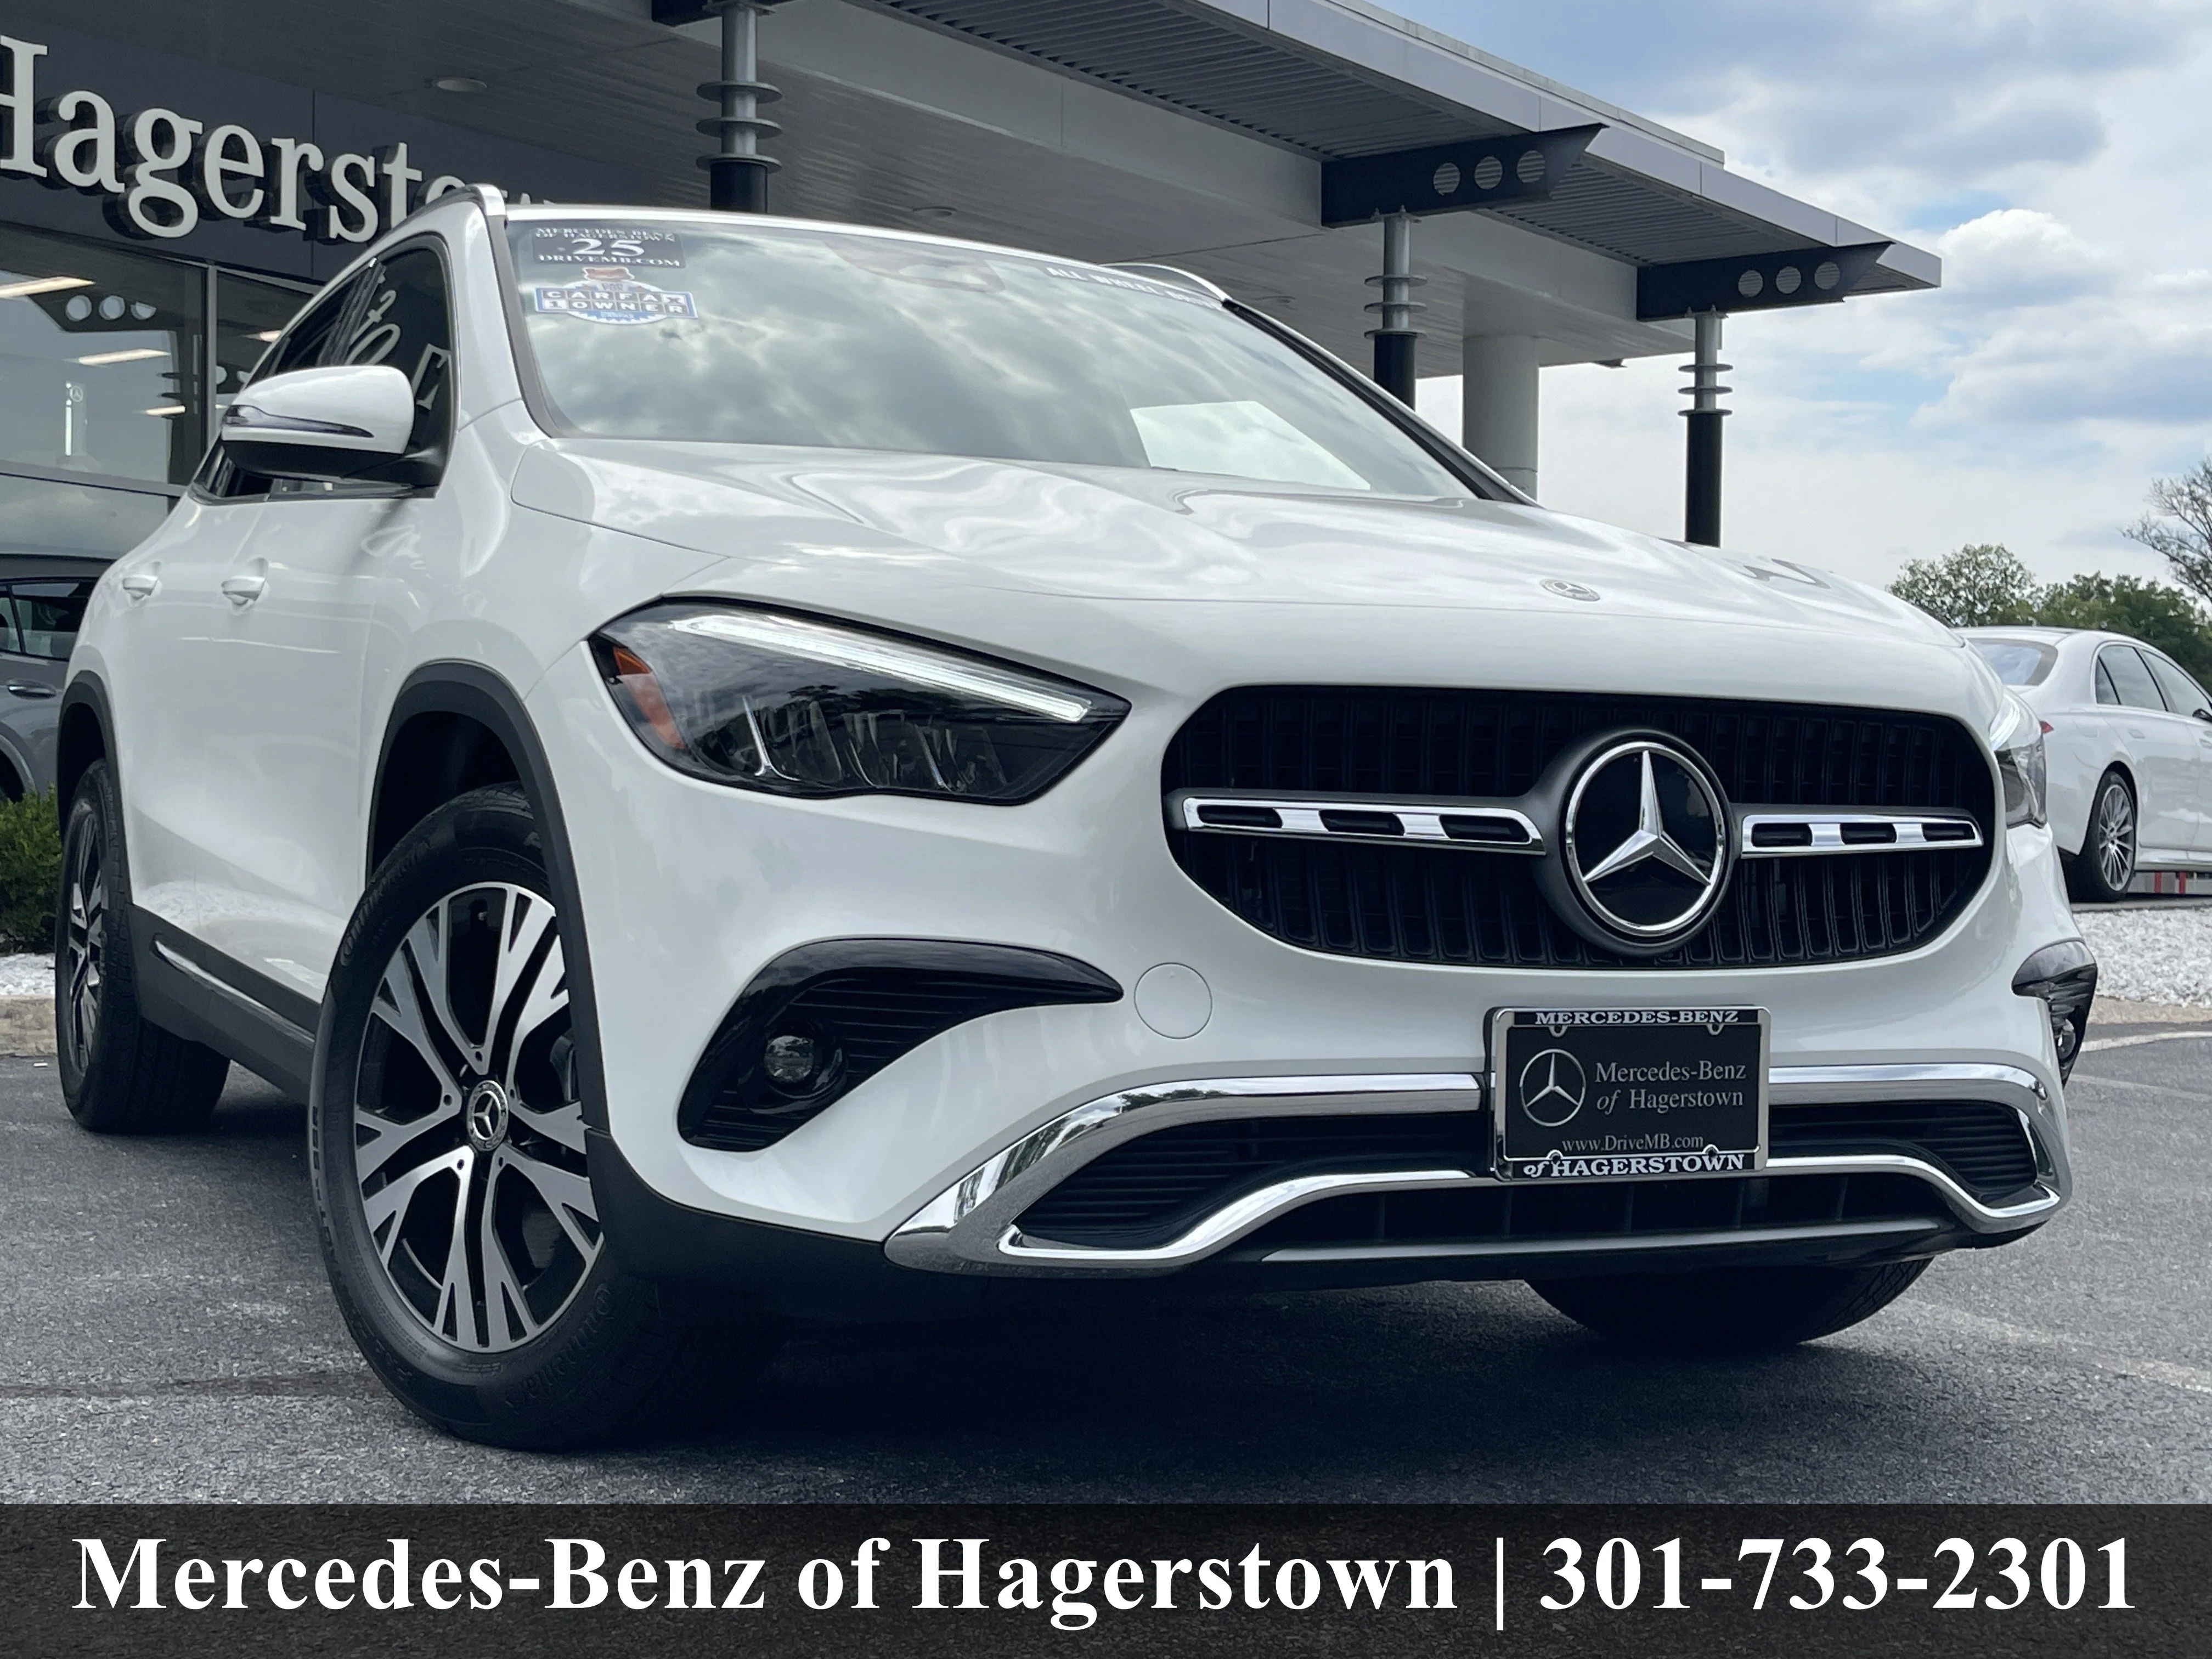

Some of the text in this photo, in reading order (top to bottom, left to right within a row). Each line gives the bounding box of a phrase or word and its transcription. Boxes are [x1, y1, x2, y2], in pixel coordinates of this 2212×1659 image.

[0, 35, 555, 242] agerst
[571, 238, 645, 257] 25
[548, 290, 684, 303] CARFAX
[574, 302, 684, 314] OWNER
[1536, 1011, 1739, 1025] MERCEDES-BENZ
[1594, 1060, 1747, 1083] Mercedes-Benz
[1596, 1088, 1744, 1115] of Hagerstown
[1561, 1133, 1704, 1152] www.DriveMB.com
[1523, 1154, 1745, 1178] of HAGERSTOWN
